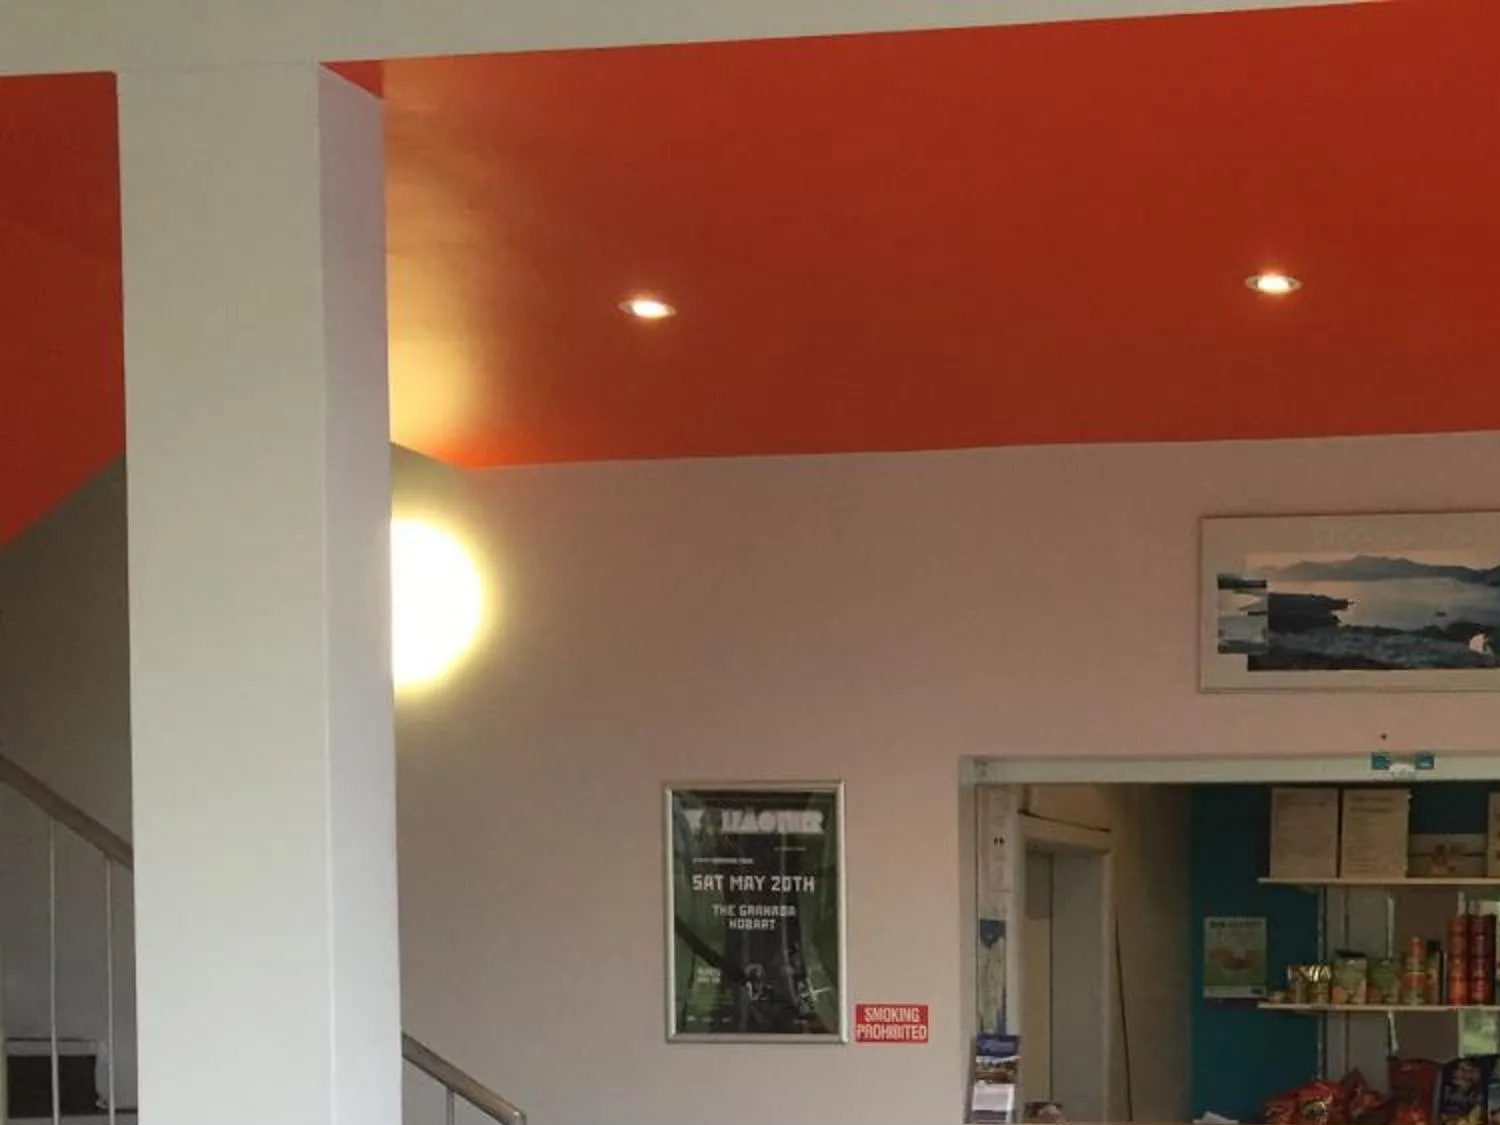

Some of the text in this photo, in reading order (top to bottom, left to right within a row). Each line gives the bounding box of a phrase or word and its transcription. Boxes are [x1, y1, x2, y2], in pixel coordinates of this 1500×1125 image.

[692, 875, 815, 894] SAT MAY 20TH
[712, 905, 796, 918] THE GRANADA
[729, 919, 776, 930] HOBART
[864, 1007, 920, 1022] SMOKING
[856, 1023, 928, 1041] PROHIBITED
